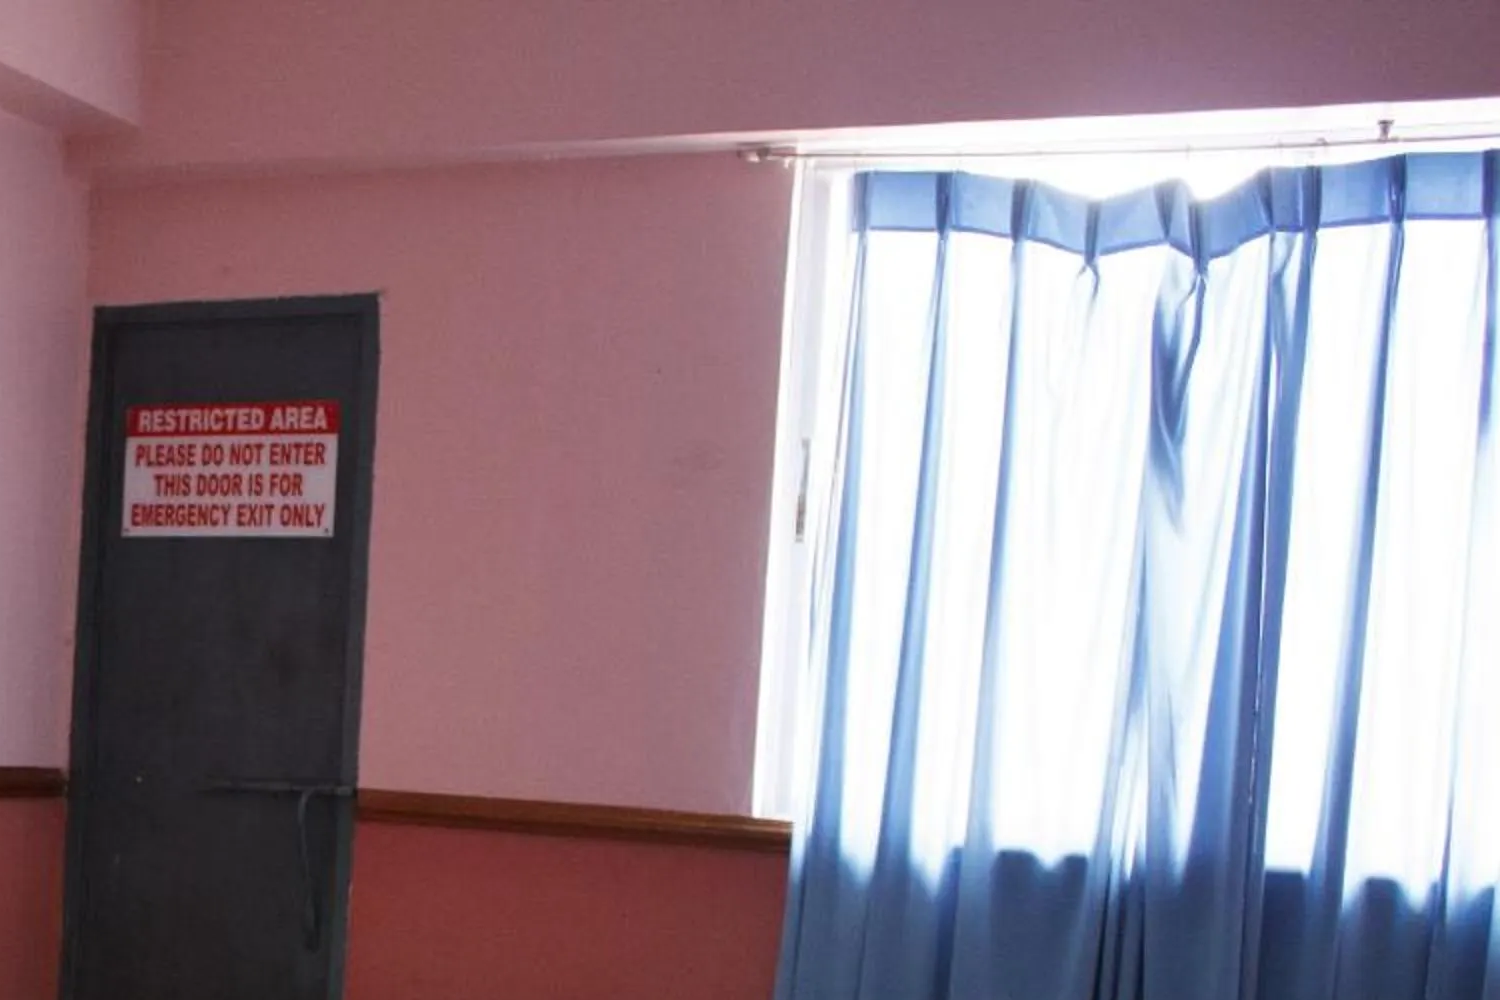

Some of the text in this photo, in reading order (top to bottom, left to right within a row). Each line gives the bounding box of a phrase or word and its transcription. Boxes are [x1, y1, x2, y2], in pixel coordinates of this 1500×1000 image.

[138, 406, 328, 432] RESTRICTED AREA
[135, 442, 326, 467] PLEASE DO NOT ENTER
[154, 474, 303, 497] THIS DOOR IS FOR
[131, 503, 325, 528] EMERGENCY EXIT ONLY
